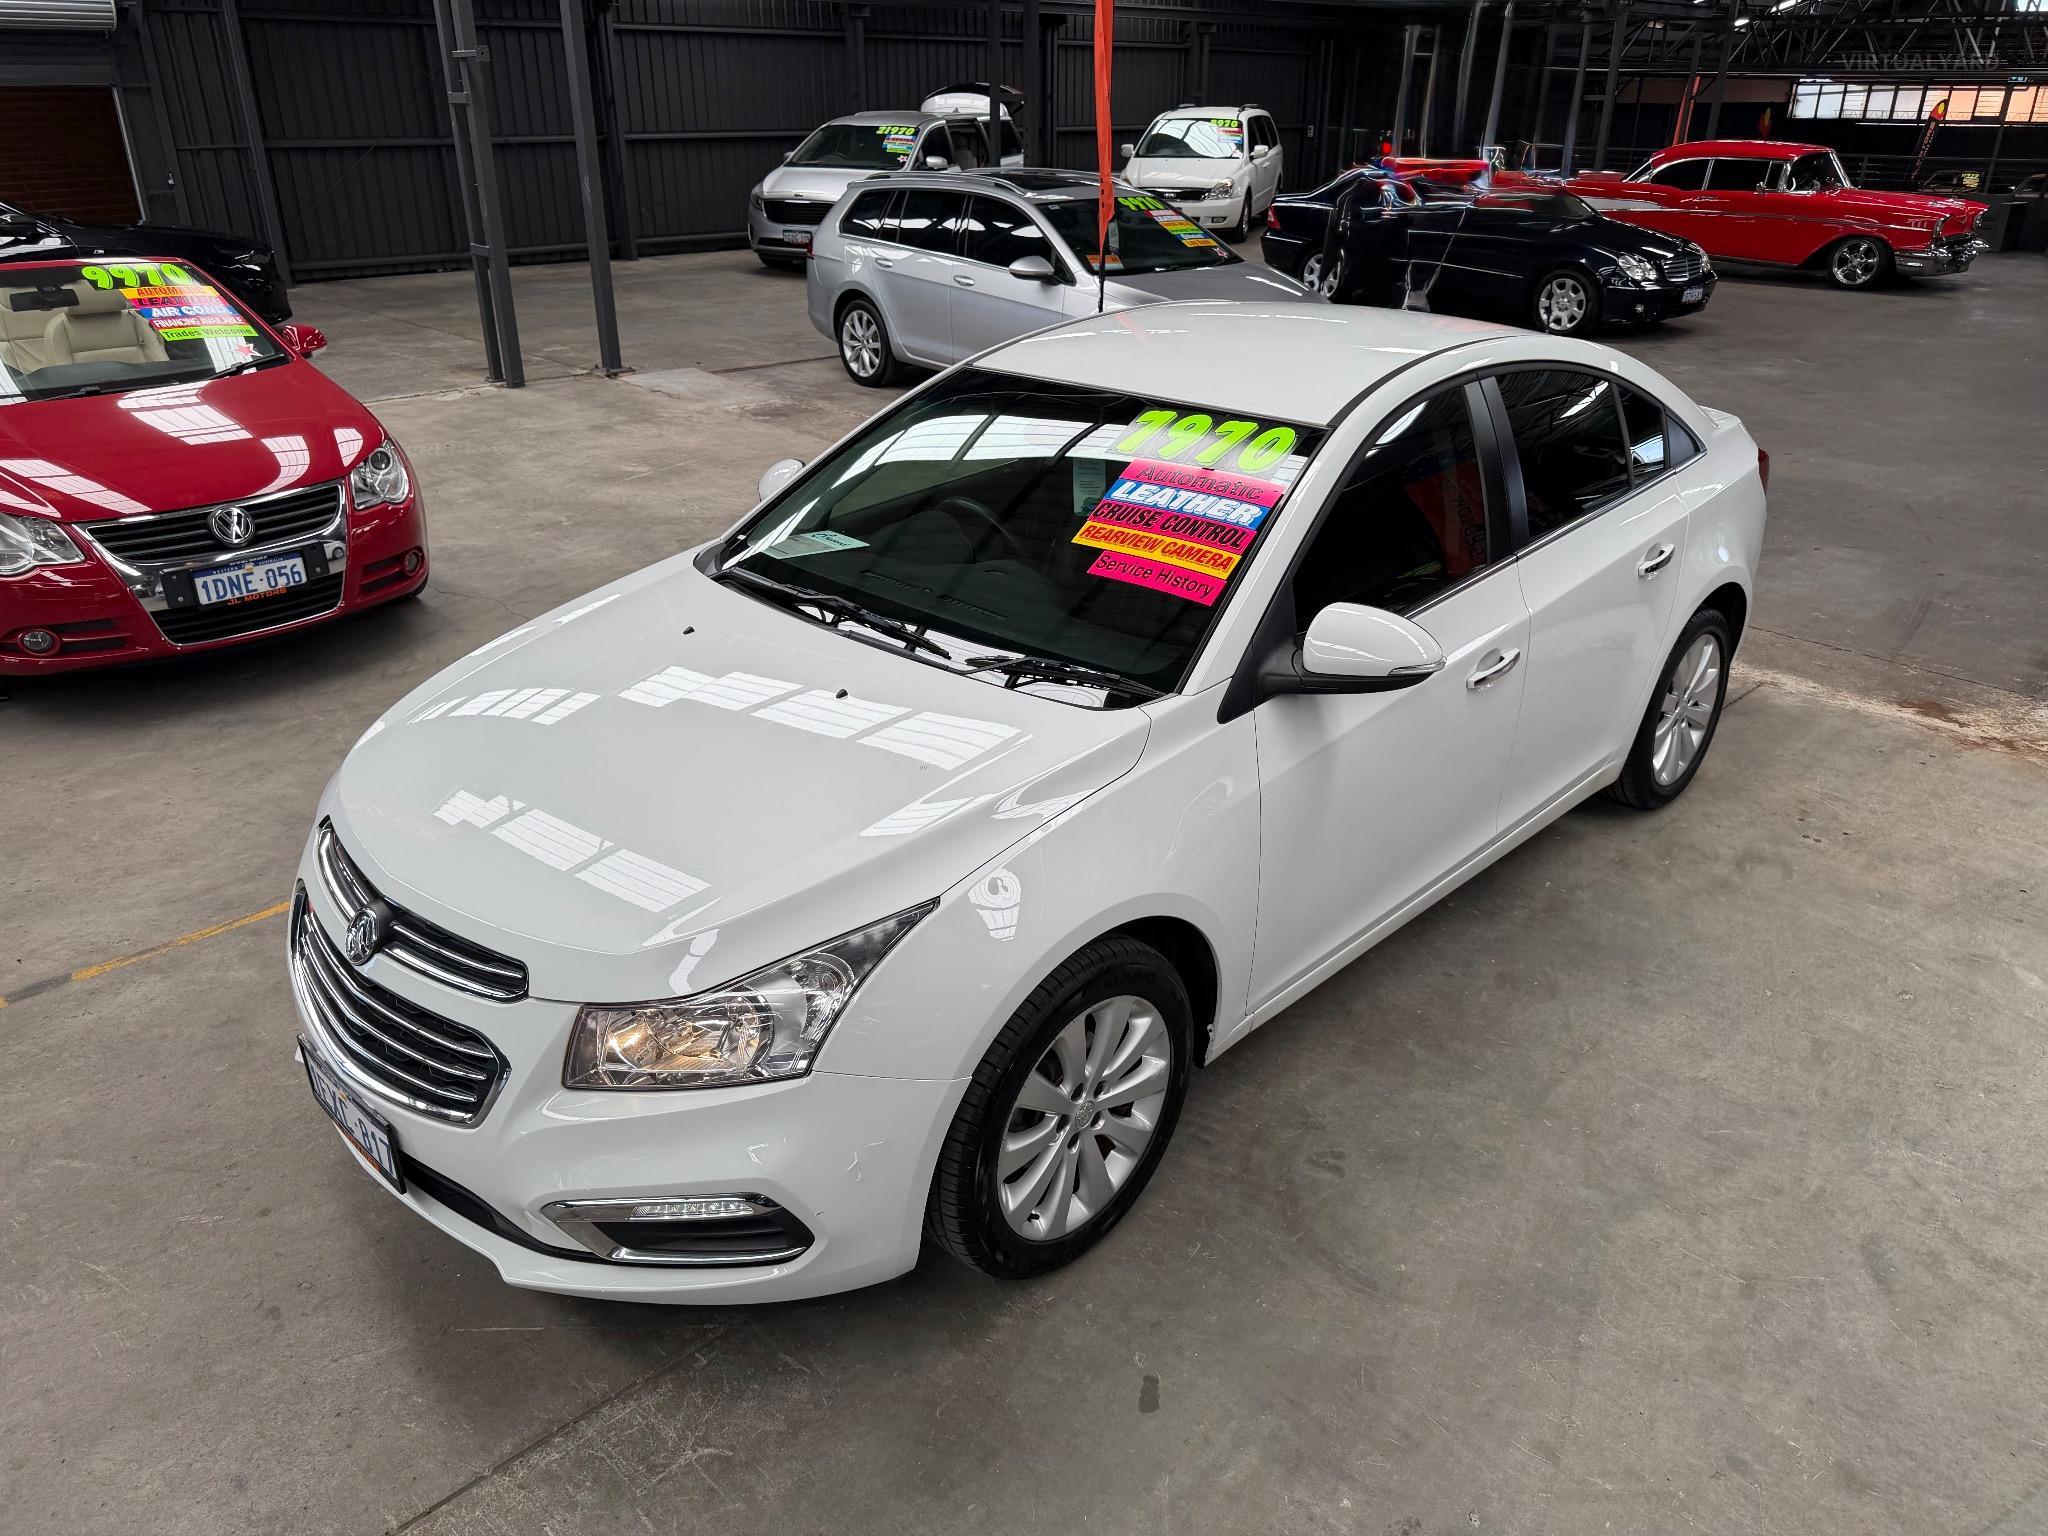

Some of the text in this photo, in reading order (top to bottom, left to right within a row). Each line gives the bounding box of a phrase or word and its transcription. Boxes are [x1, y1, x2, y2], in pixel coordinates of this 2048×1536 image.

[876, 126, 916, 136] 21970
[81, 263, 193, 290] 9970
[152, 306, 182, 318] AIR
[153, 316, 247, 328] FINANCING AVAILABLE
[162, 326, 253, 339] Trades Welcome
[1135, 464, 1264, 501] Automatic
[1110, 480, 1263, 527] LEATHER
[1093, 501, 1248, 549] CRUISE CONTROL
[1080, 525, 1236, 572] REARVIEW CAMERA
[1095, 554, 1216, 598] Service History
[244, 587, 287, 602] MOTORS
